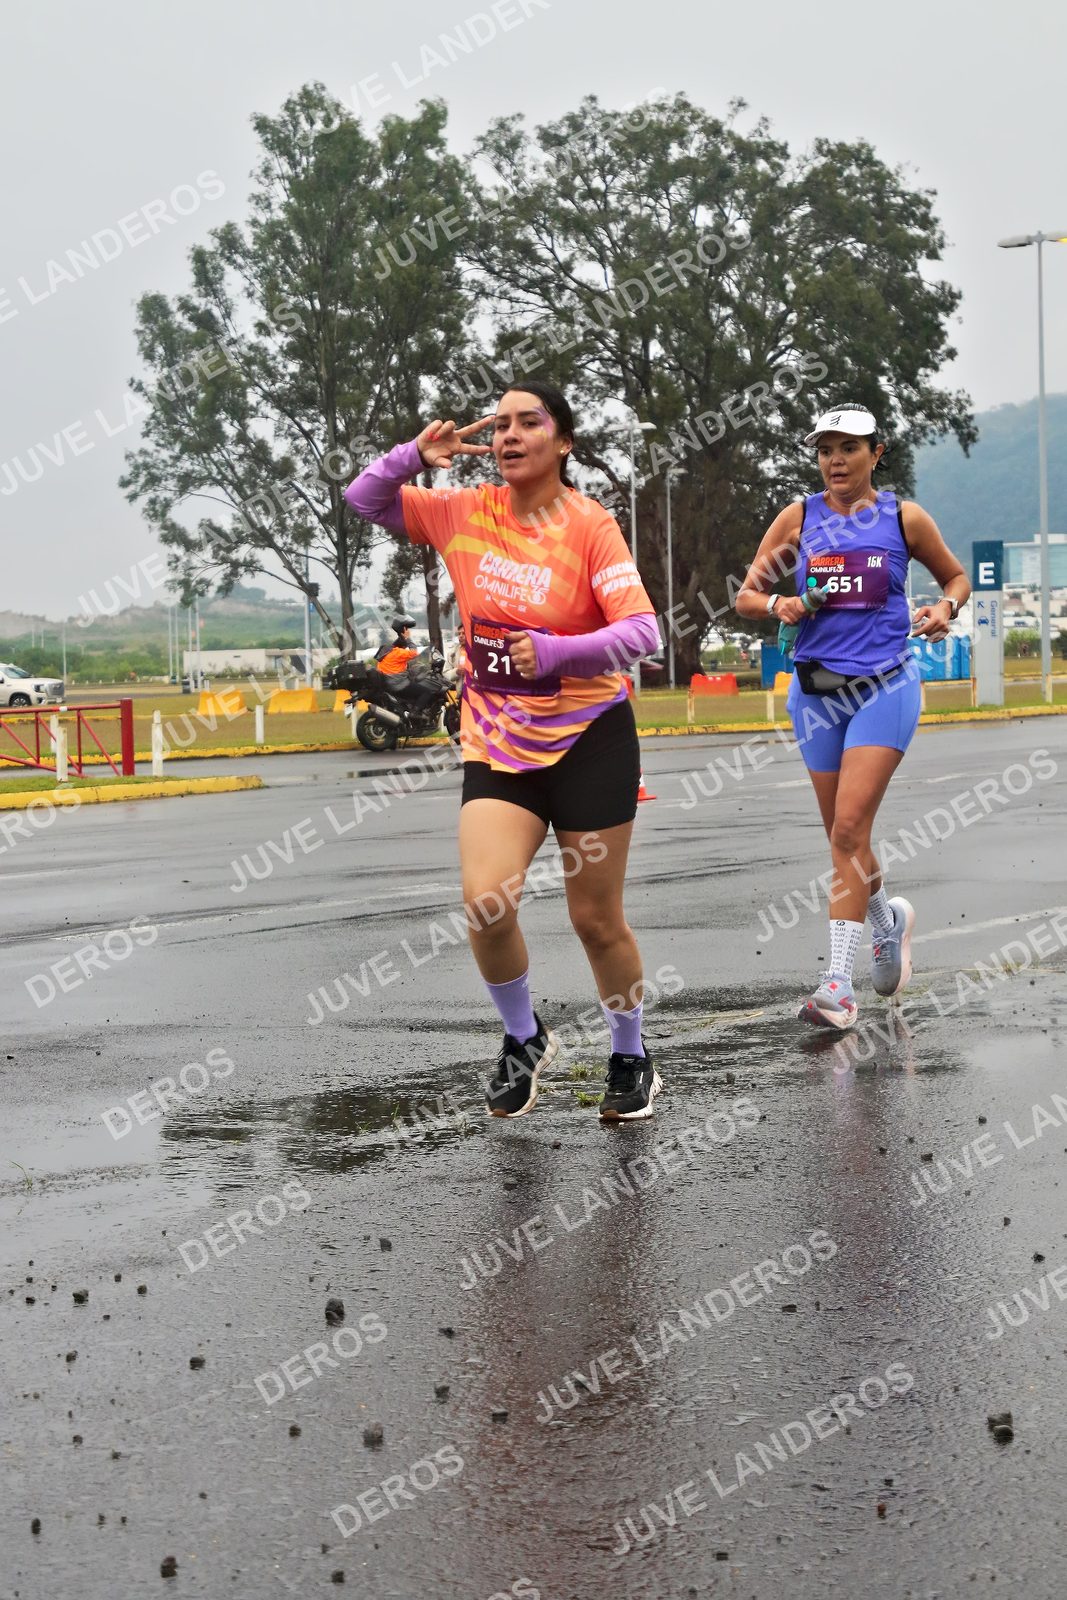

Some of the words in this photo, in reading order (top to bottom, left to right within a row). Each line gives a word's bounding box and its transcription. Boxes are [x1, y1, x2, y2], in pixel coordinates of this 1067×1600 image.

[479, 551, 553, 587] CARRERA
[810, 556, 845, 566] CARRERA
[827, 576, 863, 593] 651
[979, 562, 995, 585] E
[474, 575, 529, 602] OMNILIFE
[990, 600, 998, 637] General
[473, 635, 497, 648] OMNILIFE
[487, 652, 511, 675] 21
